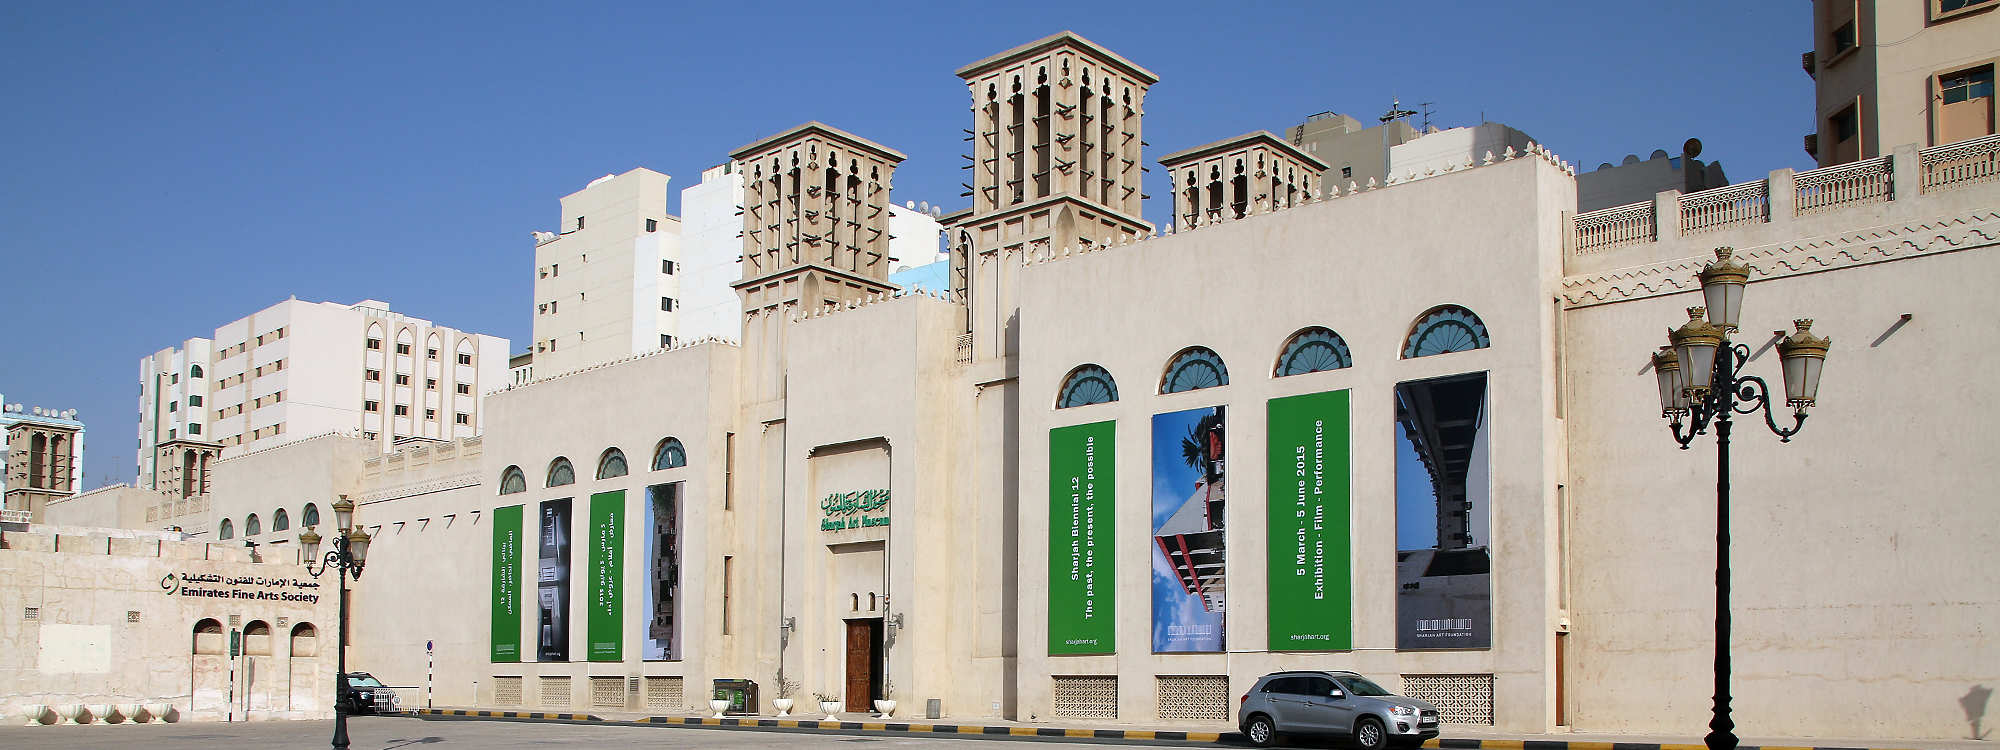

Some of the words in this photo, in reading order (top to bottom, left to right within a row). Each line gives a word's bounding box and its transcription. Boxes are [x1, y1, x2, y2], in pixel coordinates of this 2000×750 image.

[1086, 436, 1094, 480] possible
[1296, 445, 1305, 477] 2015
[1314, 420, 1323, 495] Performance
[1071, 476, 1079, 490] 12
[1296, 480, 1305, 507] June
[1071, 493, 1079, 537] Biennial
[1086, 503, 1094, 547] present,
[1314, 505, 1323, 531] Film
[1297, 527, 1305, 565] March
[1071, 540, 1080, 580] Sharjah
[1296, 568, 1305, 576] 5
[1314, 540, 1323, 600] Exhibition
[181, 573, 224, 583] التشكيلية
[226, 577, 254, 586] للفنون
[255, 577, 290, 588] الإمارات
[292, 578, 320, 590] جمعية
[1086, 571, 1094, 597] past,
[181, 587, 230, 598] Emirates
[232, 589, 255, 599] Fine
[257, 591, 279, 601] Arts
[281, 592, 319, 604] Society
